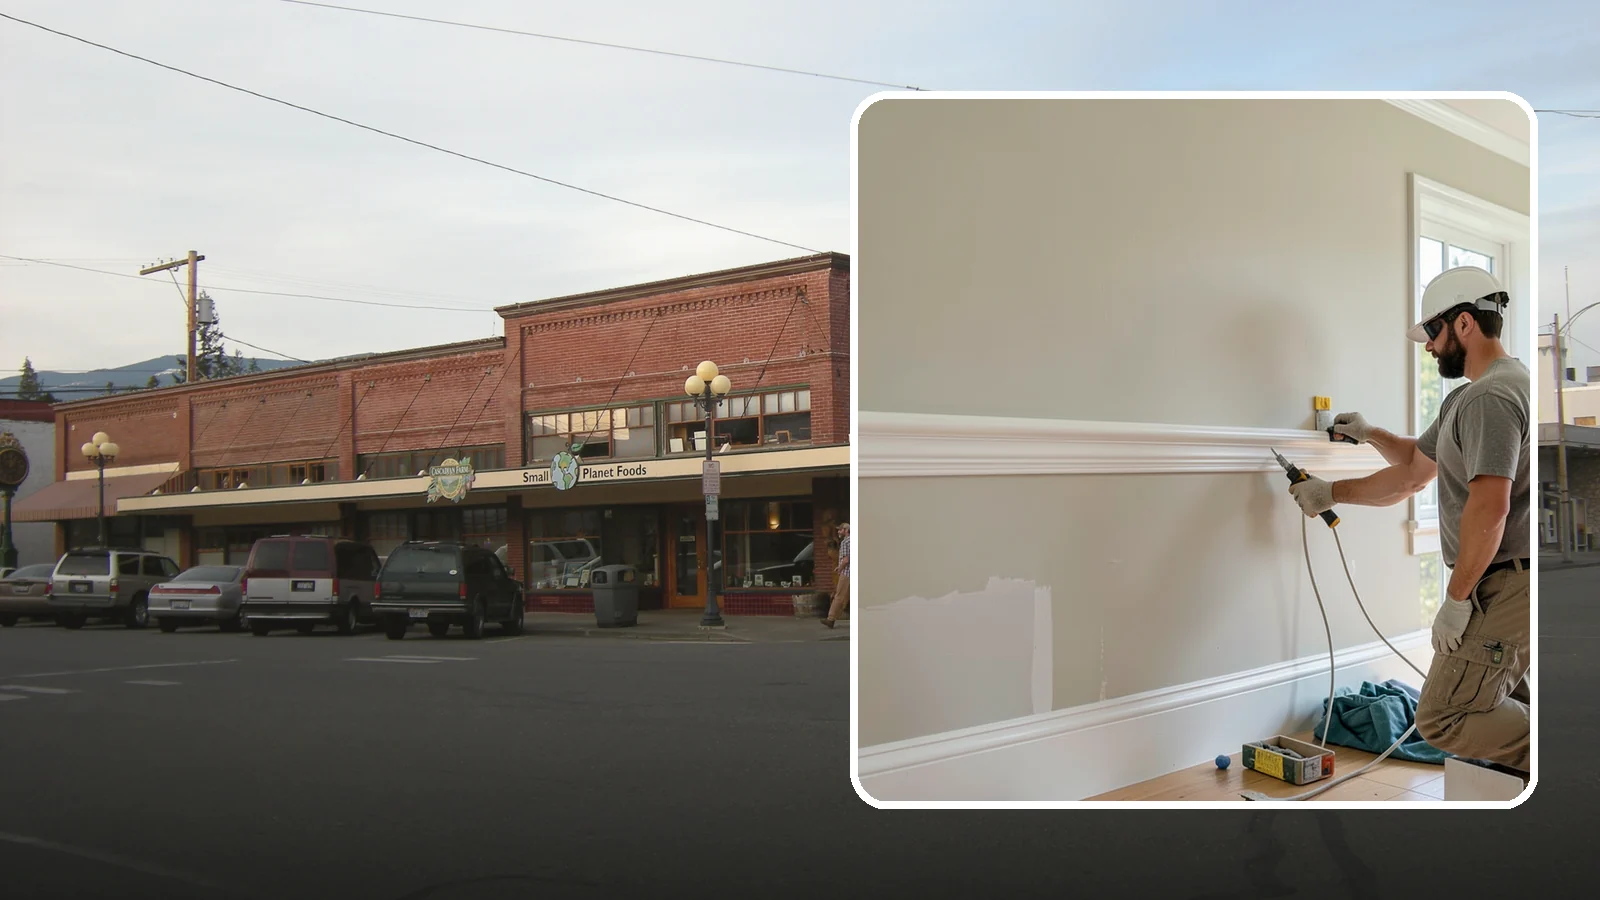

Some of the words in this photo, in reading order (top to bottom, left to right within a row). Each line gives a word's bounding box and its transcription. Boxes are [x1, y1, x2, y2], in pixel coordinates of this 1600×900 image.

[523, 471, 549, 483] Small
[583, 467, 614, 479] Planet
[617, 465, 647, 477] Foods
